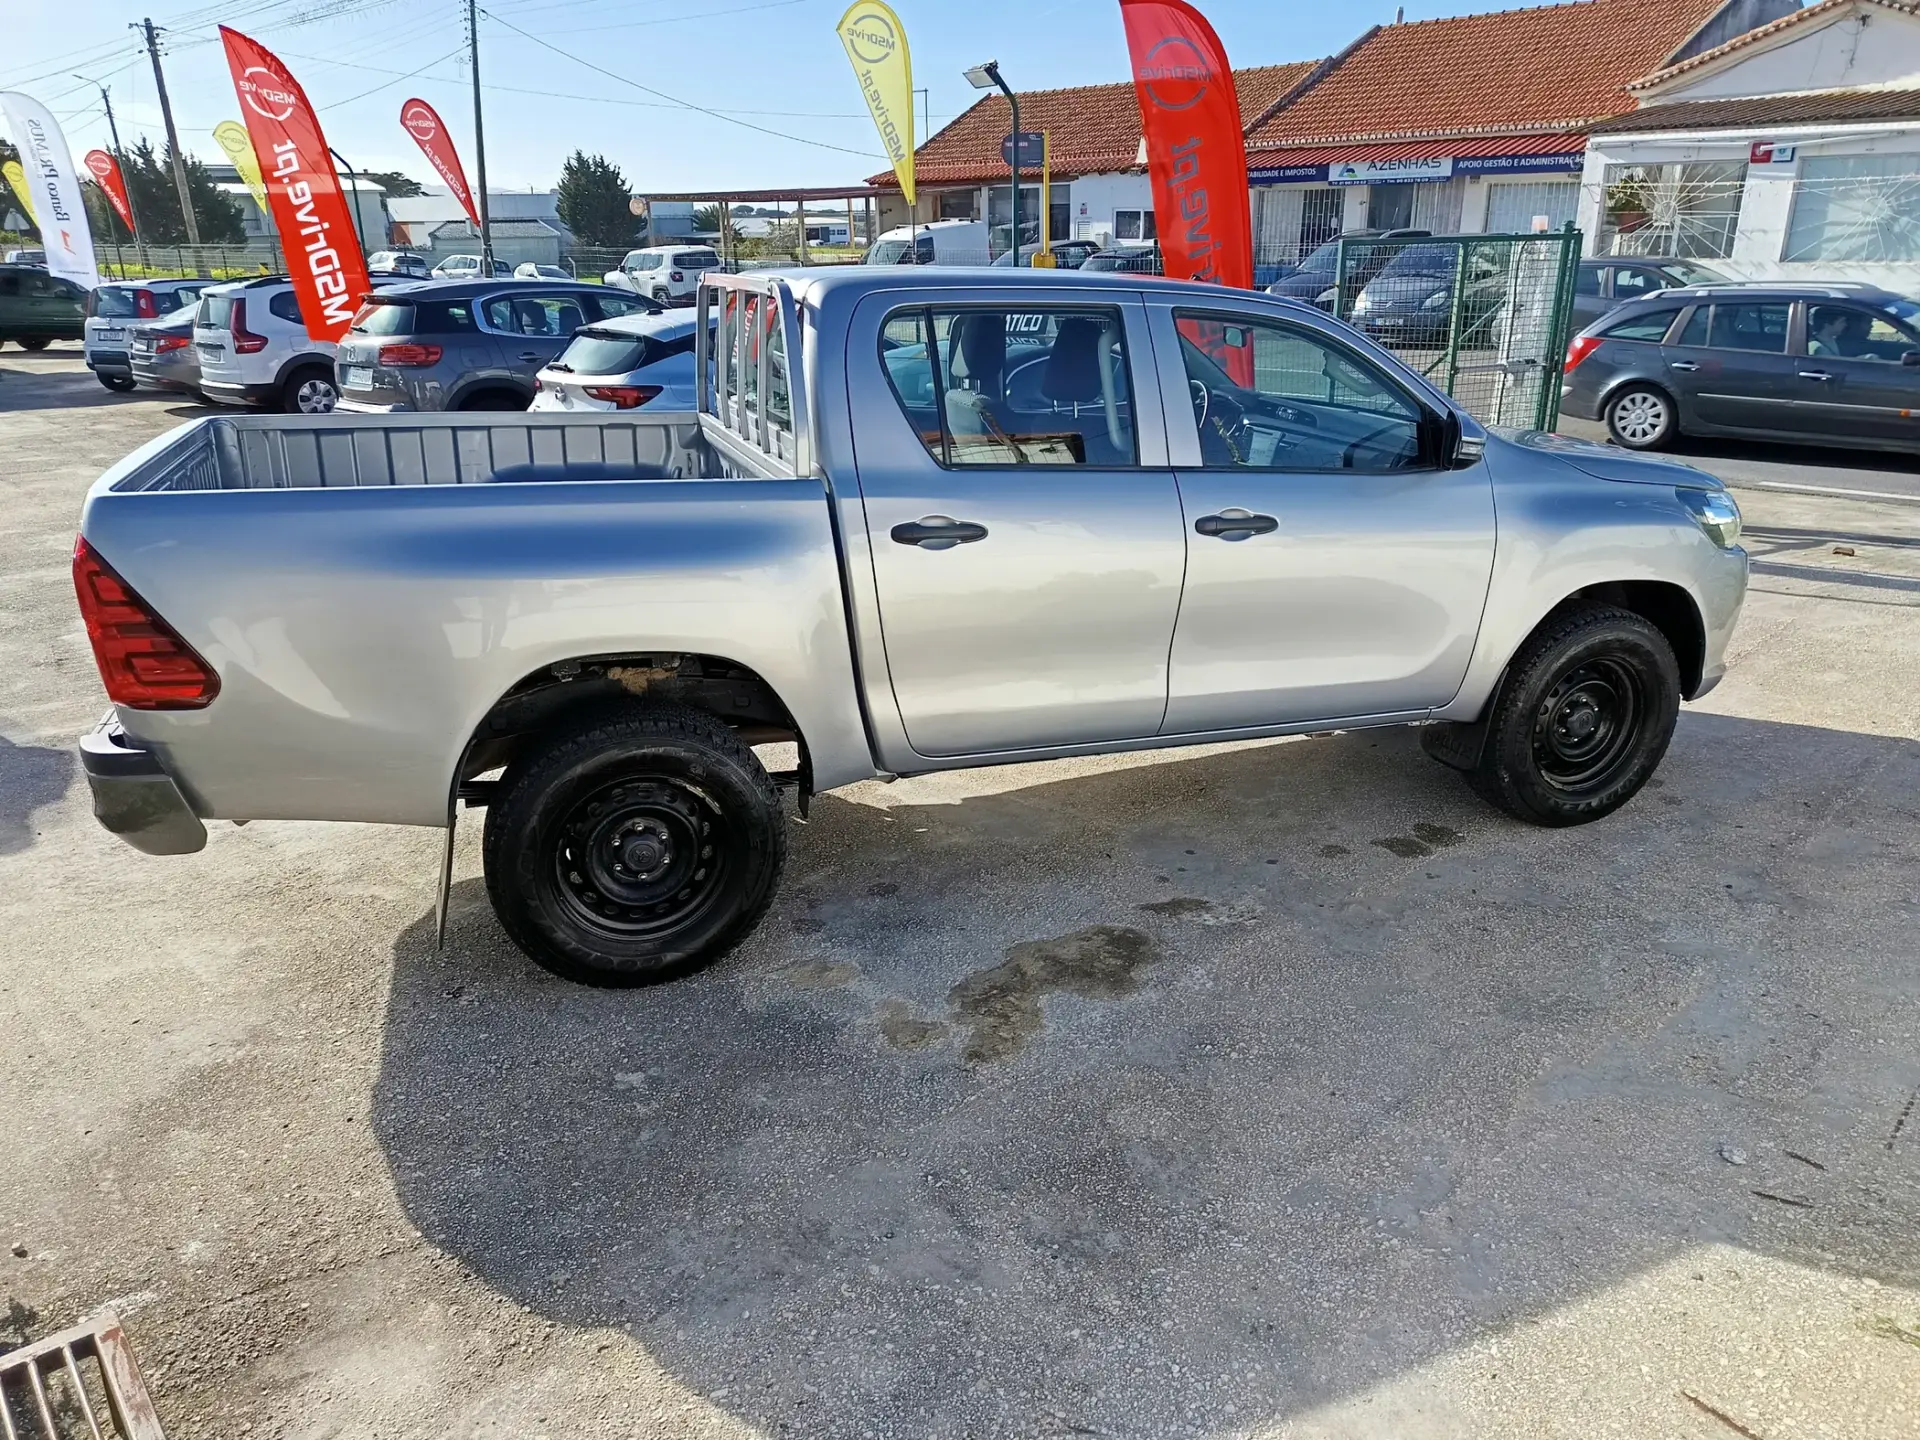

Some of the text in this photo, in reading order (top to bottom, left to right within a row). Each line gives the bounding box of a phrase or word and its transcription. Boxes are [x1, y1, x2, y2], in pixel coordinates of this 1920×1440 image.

[1367, 157, 1442, 171] AZENHAS
[1458, 159, 1482, 168] APOIO
[1484, 157, 1512, 168] GESTÃO
[1514, 158, 1518, 166] E
[1285, 168, 1316, 176] IMPOSTOS
